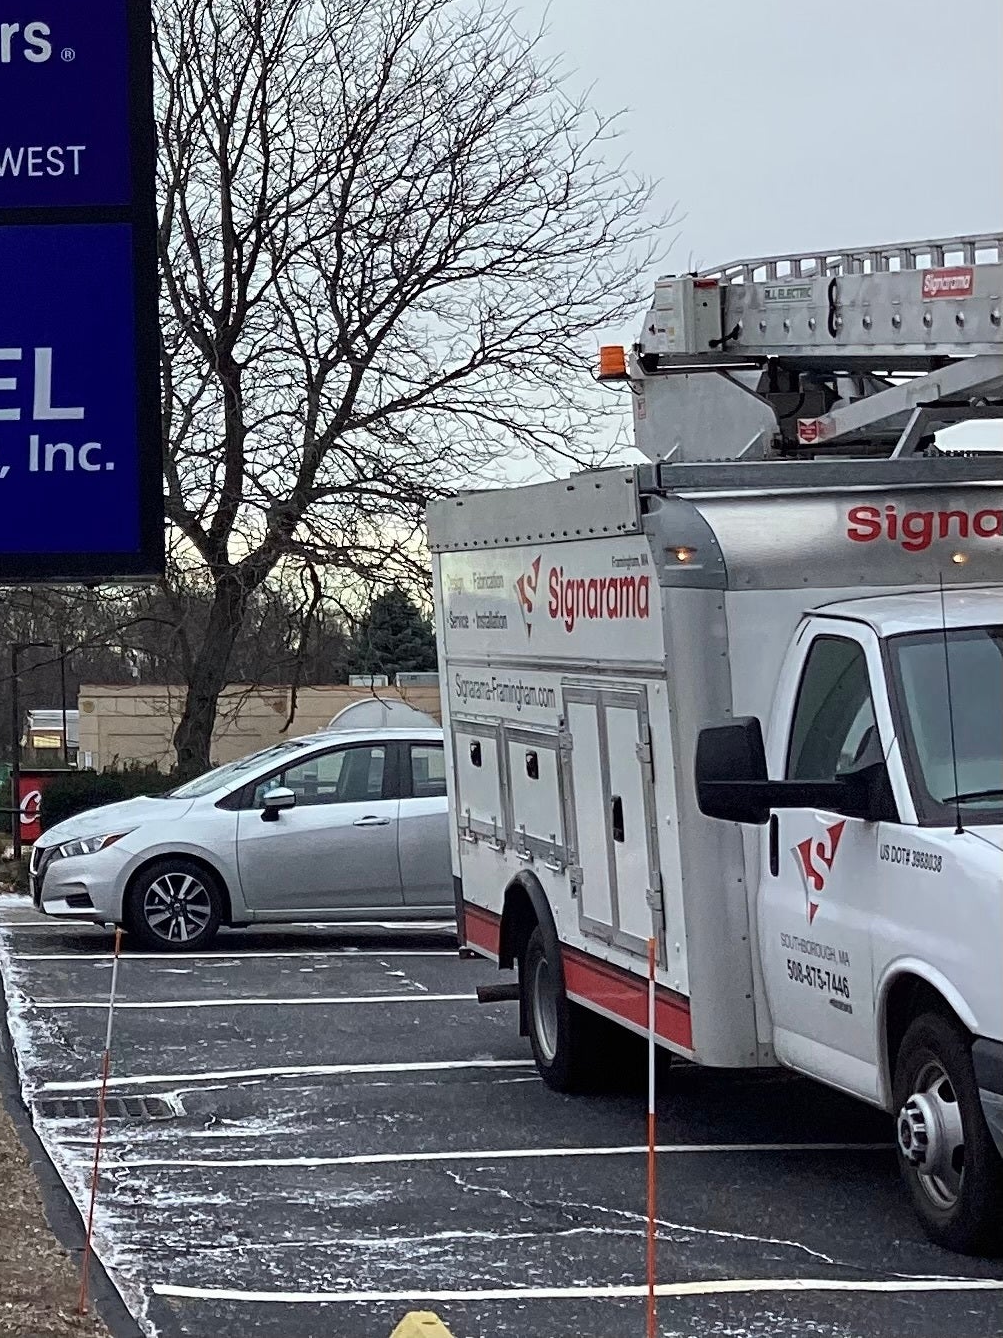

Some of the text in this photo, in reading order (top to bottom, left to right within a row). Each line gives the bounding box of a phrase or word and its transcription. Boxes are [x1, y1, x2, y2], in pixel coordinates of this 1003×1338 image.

[28, 434, 116, 472] Inc.
[549, 566, 648, 633] Signarama
[787, 958, 850, 998] 508-875-7446
